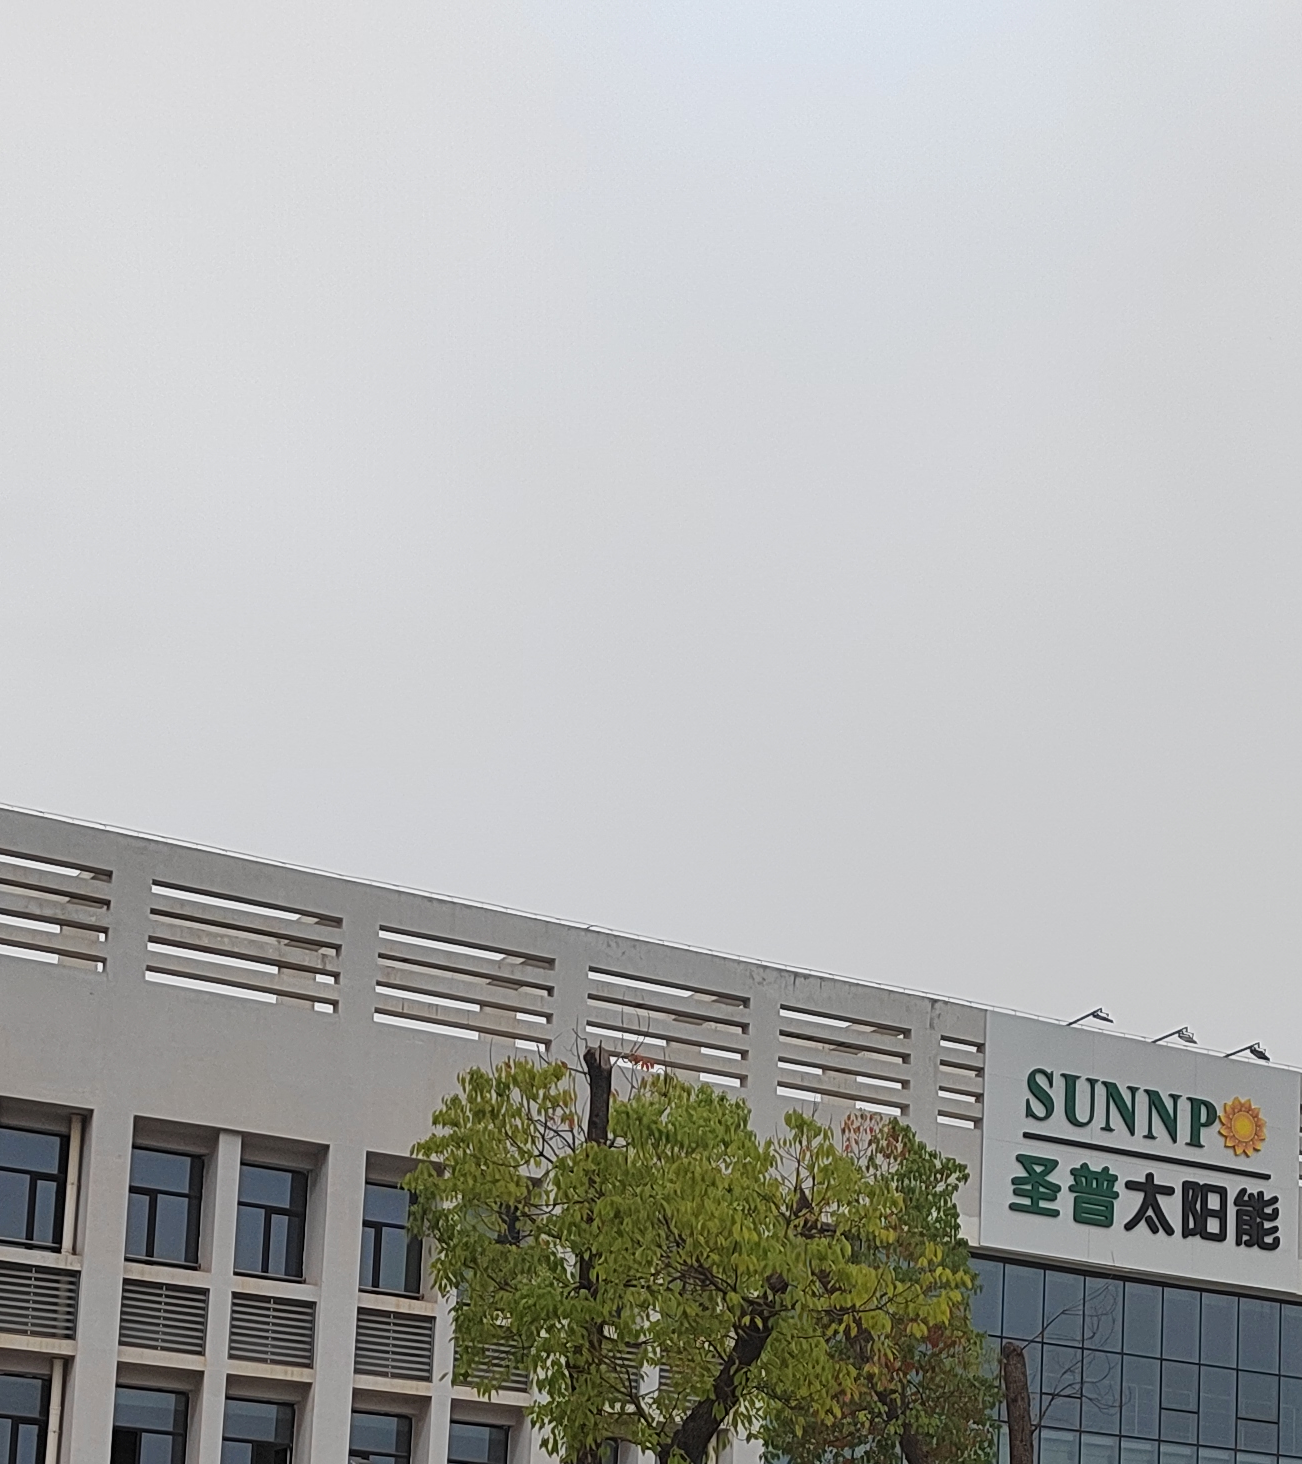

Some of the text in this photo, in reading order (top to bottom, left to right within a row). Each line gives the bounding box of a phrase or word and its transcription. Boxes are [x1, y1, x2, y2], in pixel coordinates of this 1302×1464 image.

[1008, 1153, 1280, 1251] 圣普太阳能
